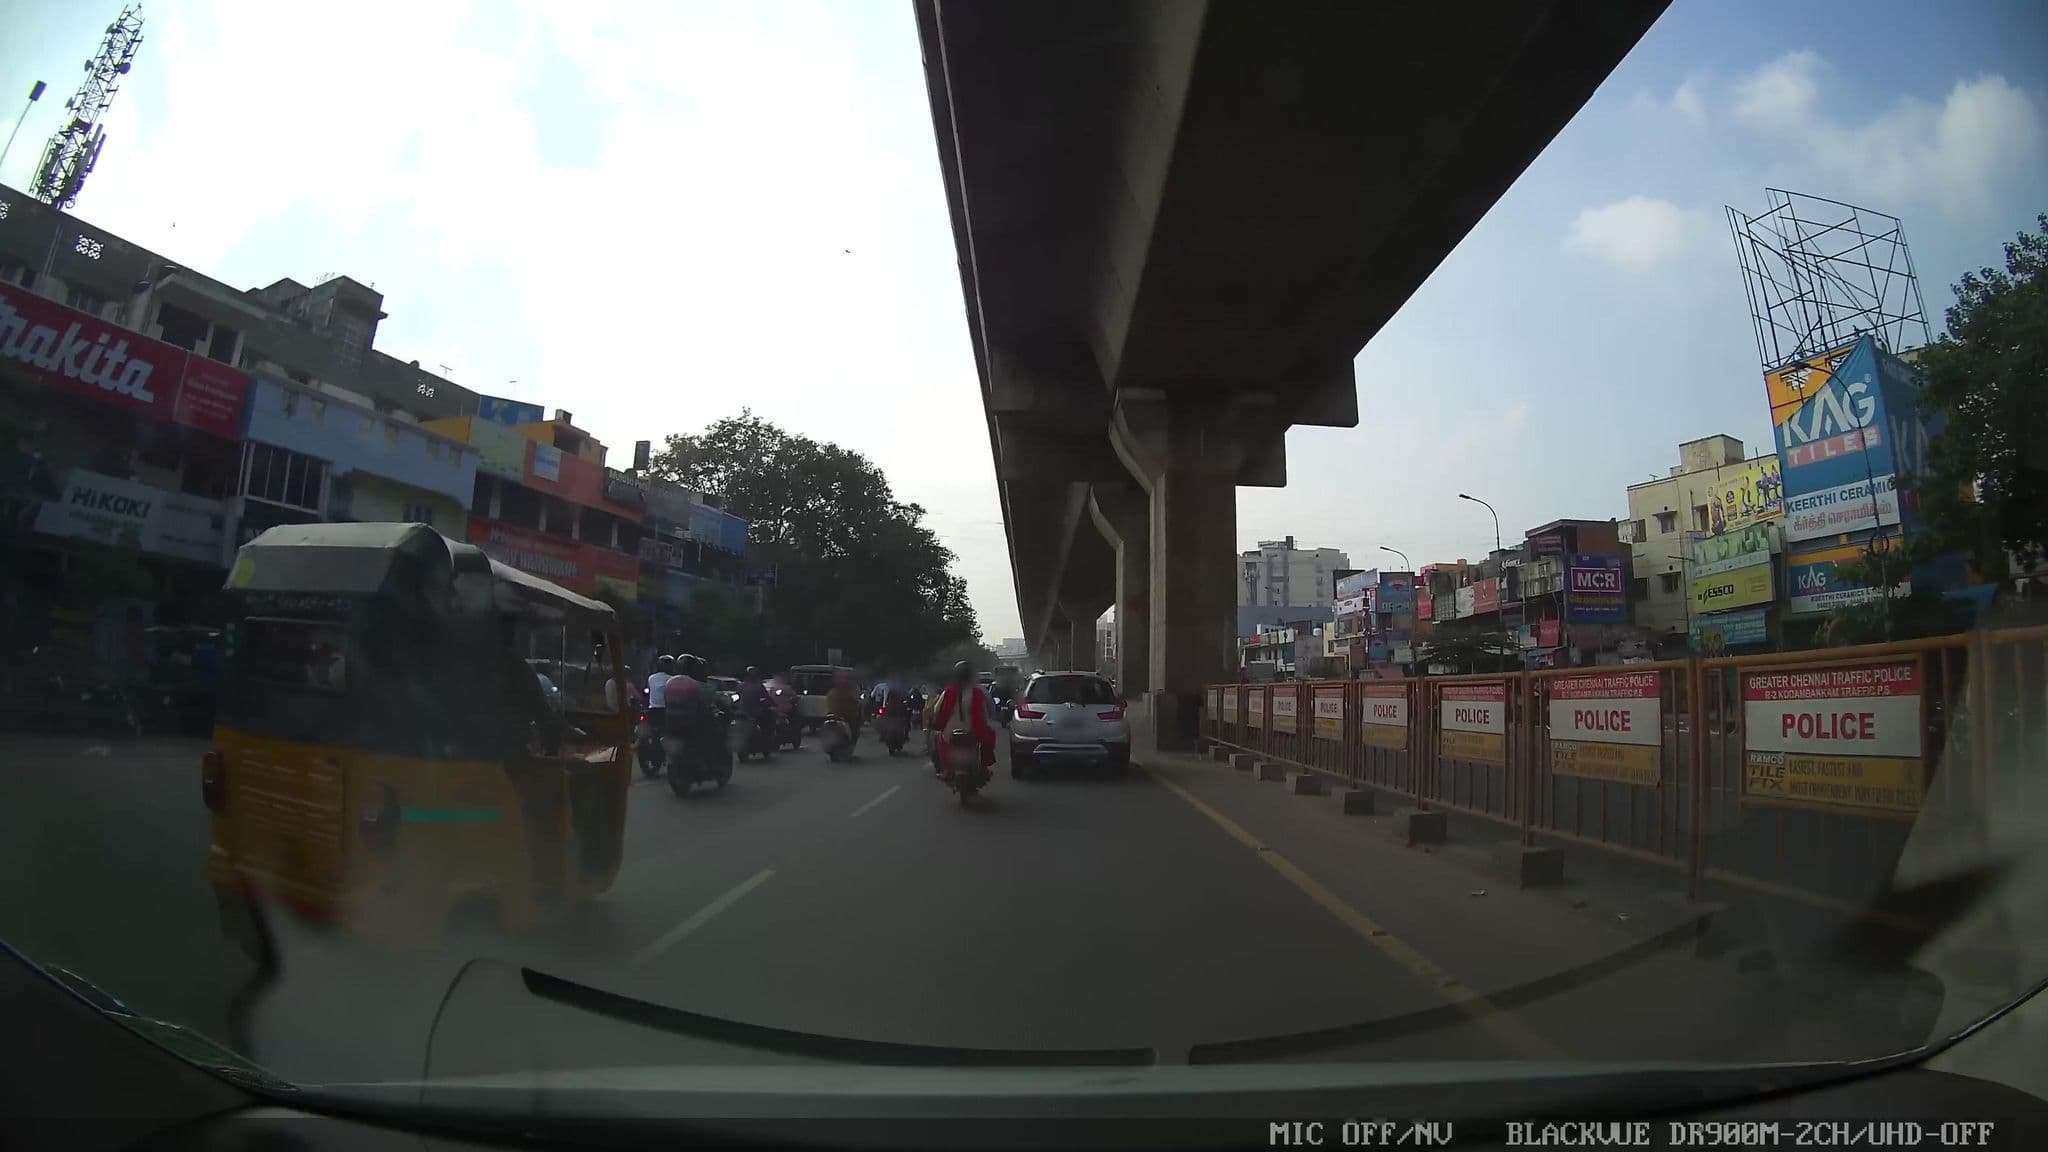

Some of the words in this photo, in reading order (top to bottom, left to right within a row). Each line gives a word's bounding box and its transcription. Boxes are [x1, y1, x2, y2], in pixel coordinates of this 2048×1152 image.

[1782, 382, 1875, 448] KAG
[1789, 429, 1878, 464] TILES
[1787, 492, 1836, 513] KEERTHI
[1577, 572, 1615, 588] MCR
[1798, 565, 1826, 590] KAG
[1629, 675, 1654, 687] POLICE
[1750, 675, 1788, 689] GREATER
[1791, 672, 1830, 688] CHENNAI
[1832, 669, 1872, 685] TRAFFIC
[1874, 666, 1912, 683] POLICE
[1841, 685, 1875, 697] TRAFFIC
[1373, 704, 1397, 718] POLICE
[1455, 708, 1490, 724] POLICE
[1574, 709, 1631, 732] POLICE
[1782, 712, 1875, 740] POLICE
[1750, 752, 1785, 765] RAMCO
[1749, 765, 1785, 778] TILE
